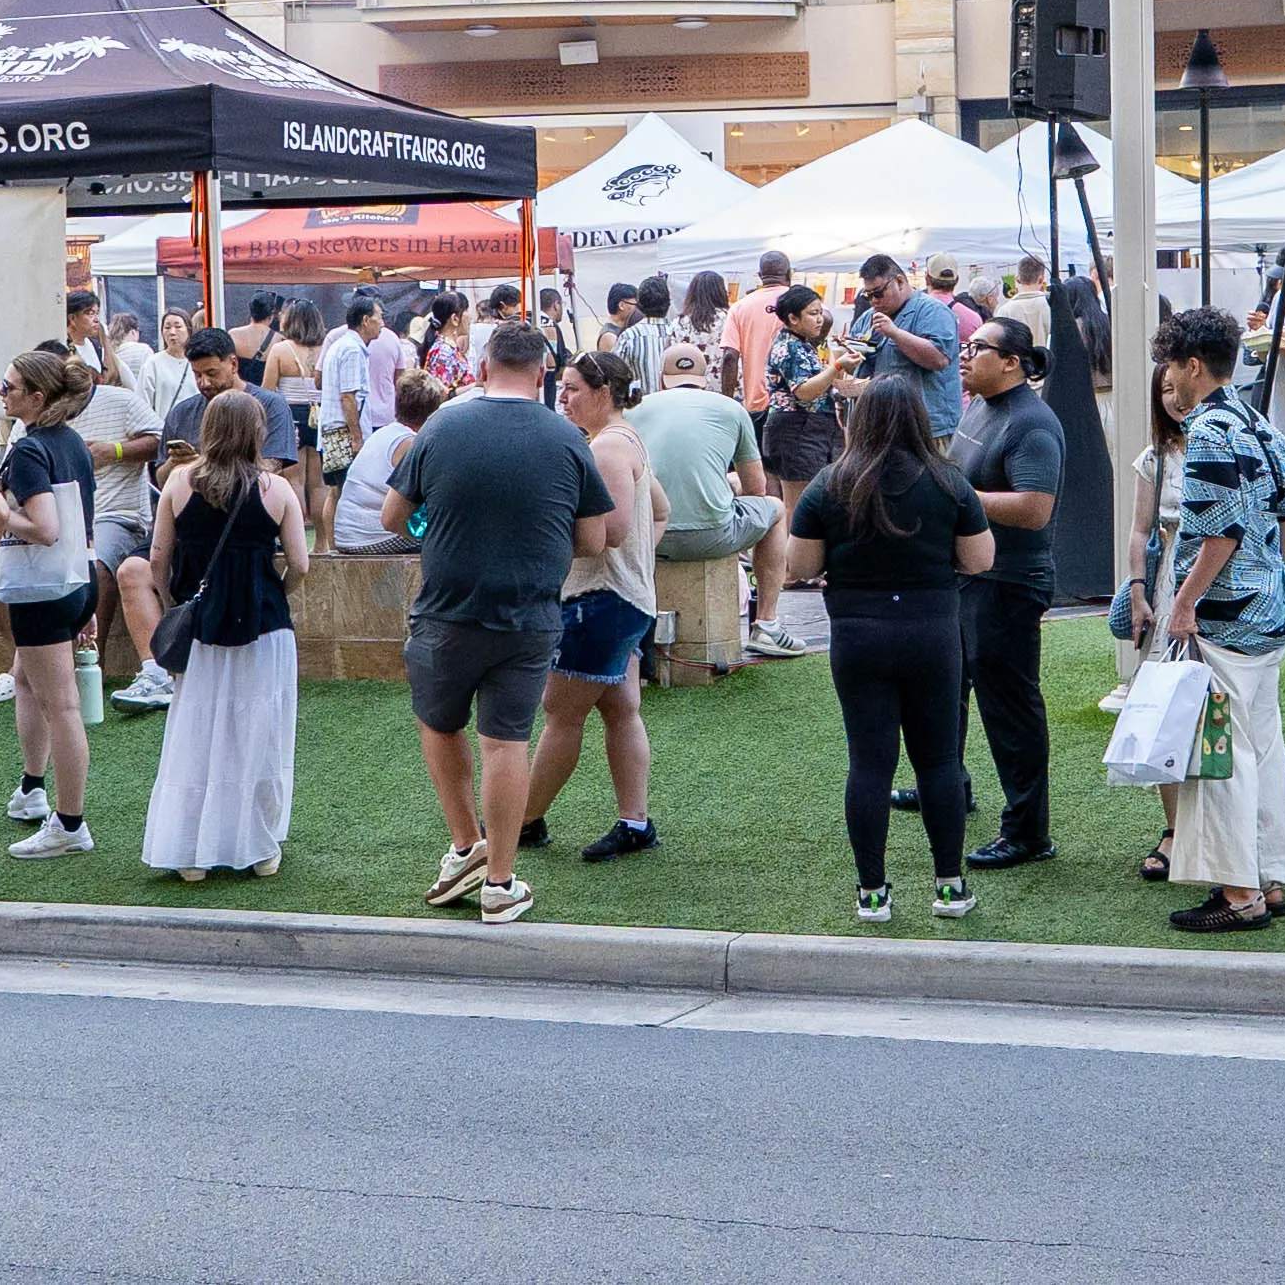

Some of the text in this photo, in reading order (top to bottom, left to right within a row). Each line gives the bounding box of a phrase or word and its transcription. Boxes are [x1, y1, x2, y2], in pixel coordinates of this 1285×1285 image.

[283, 120, 486, 171] ISLANDCRAFTFAIRS.ORG
[249, 238, 304, 262] BBQ
[307, 235, 399, 255] skewers
[406, 235, 431, 253] in
[437, 232, 519, 255] Hawaii
